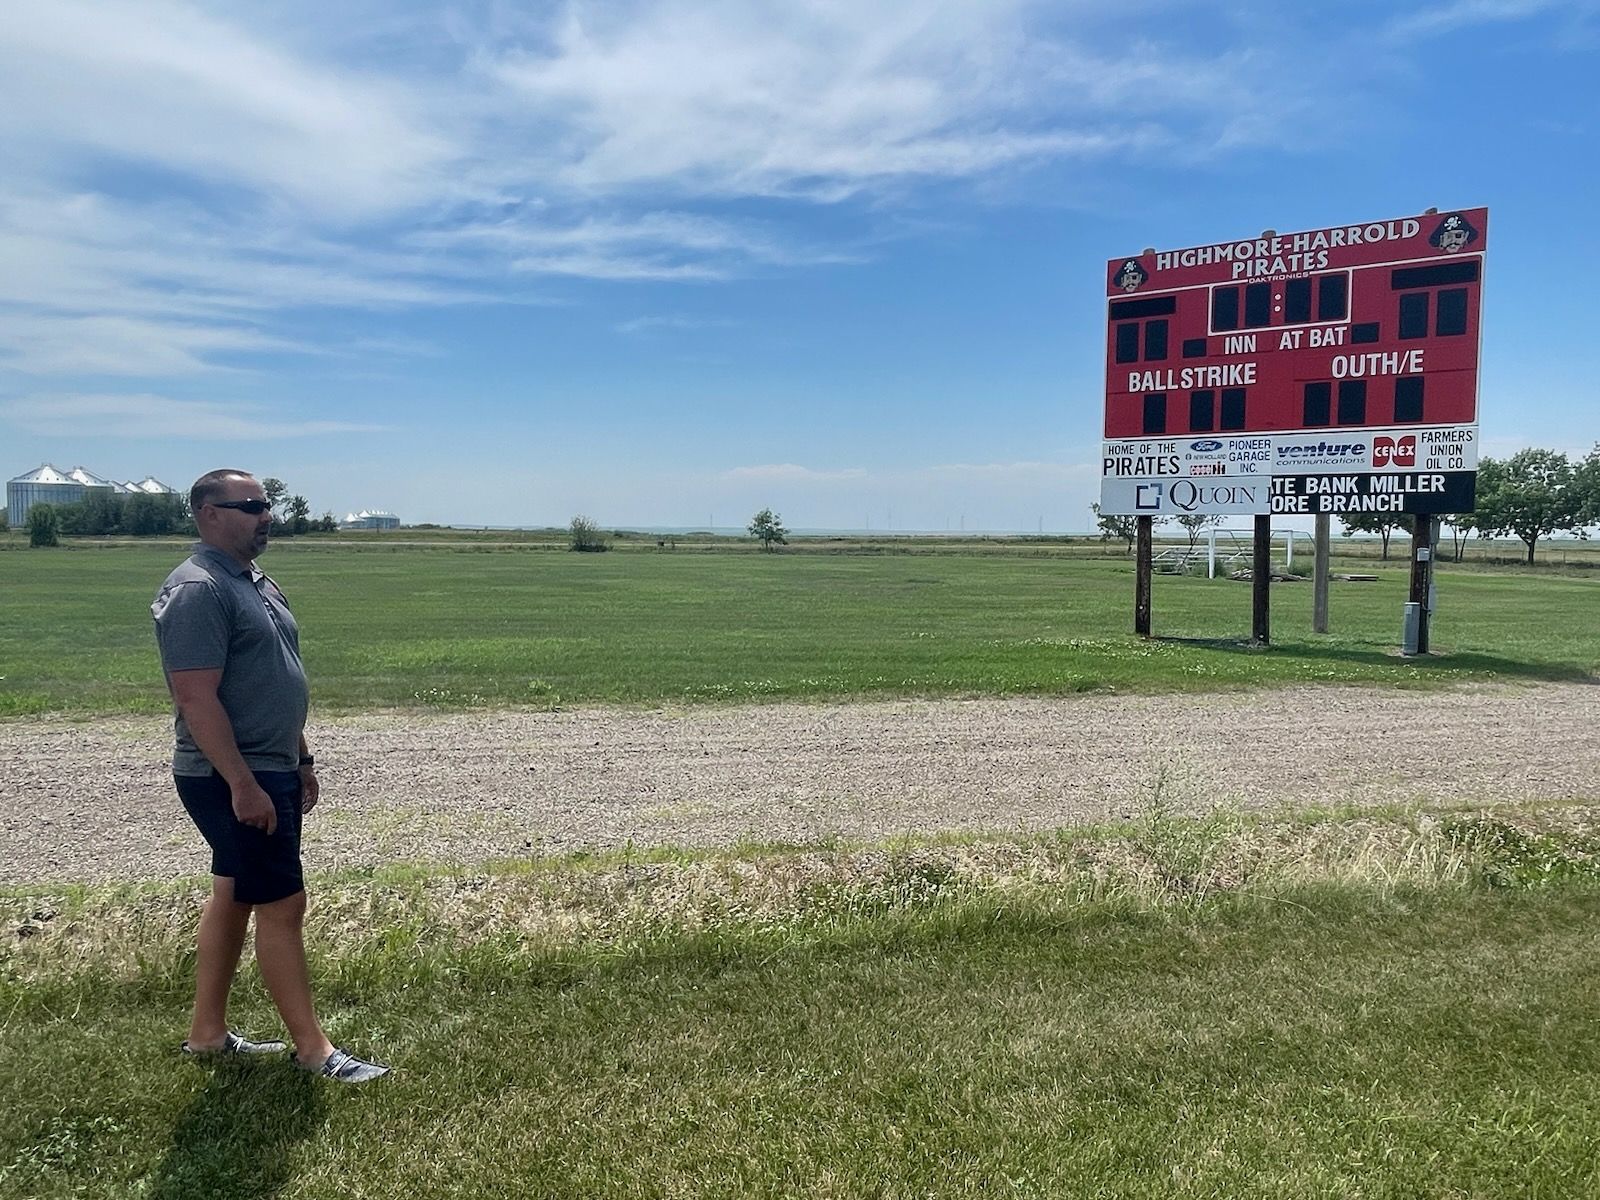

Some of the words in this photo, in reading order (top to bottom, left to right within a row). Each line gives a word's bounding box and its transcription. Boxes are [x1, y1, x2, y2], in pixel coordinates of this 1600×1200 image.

[1156, 219, 1420, 271] HIGHMORE-HARROLD
[1232, 250, 1329, 279] PIRATES
[1248, 272, 1309, 284] DAKTRONICS
[1224, 334, 1257, 354] INN
[1279, 330, 1303, 351] AT
[1309, 327, 1347, 348] BAT
[1421, 430, 1473, 443] FARMERS
[1108, 444, 1135, 455] HOME
[1139, 443, 1151, 454] OF
[1158, 442, 1176, 453] THE
[1229, 440, 1271, 450] PIONEER
[1276, 442, 1366, 457] venture
[1374, 445, 1415, 460] CENEX
[1430, 444, 1463, 456] UNION
[1229, 451, 1271, 462] GARAGE
[1276, 457, 1366, 466] communications
[1426, 457, 1442, 469] OIL
[1448, 457, 1466, 469] CO.
[1103, 456, 1180, 476] PIRATES
[1240, 463, 1258, 473] INC.
[1306, 475, 1358, 494] BANK
[1370, 474, 1446, 493] MILLER
[1169, 480, 1256, 511] QUOIN
[1320, 493, 1404, 512] BRANCH
